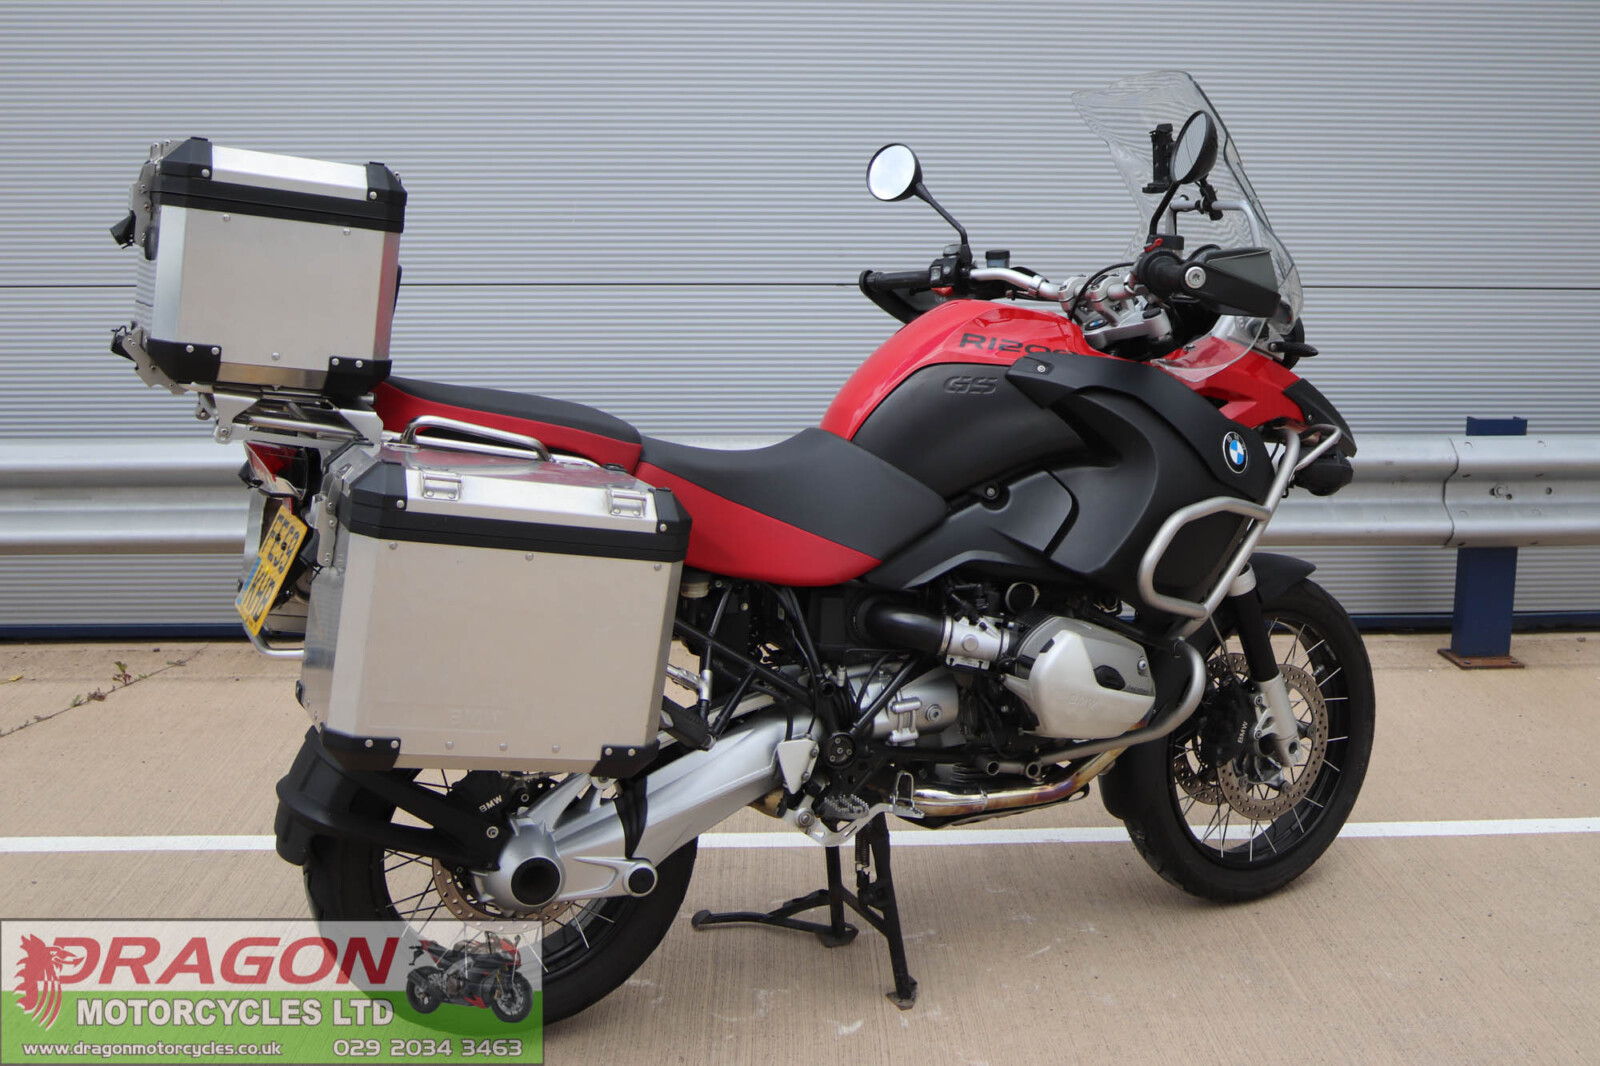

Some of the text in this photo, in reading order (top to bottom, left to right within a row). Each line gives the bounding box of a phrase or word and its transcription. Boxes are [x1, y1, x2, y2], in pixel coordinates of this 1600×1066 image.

[959, 333, 1075, 354] R120
[943, 375, 998, 395] GS
[1237, 720, 1249, 744] BMW
[478, 794, 503, 813] BMW
